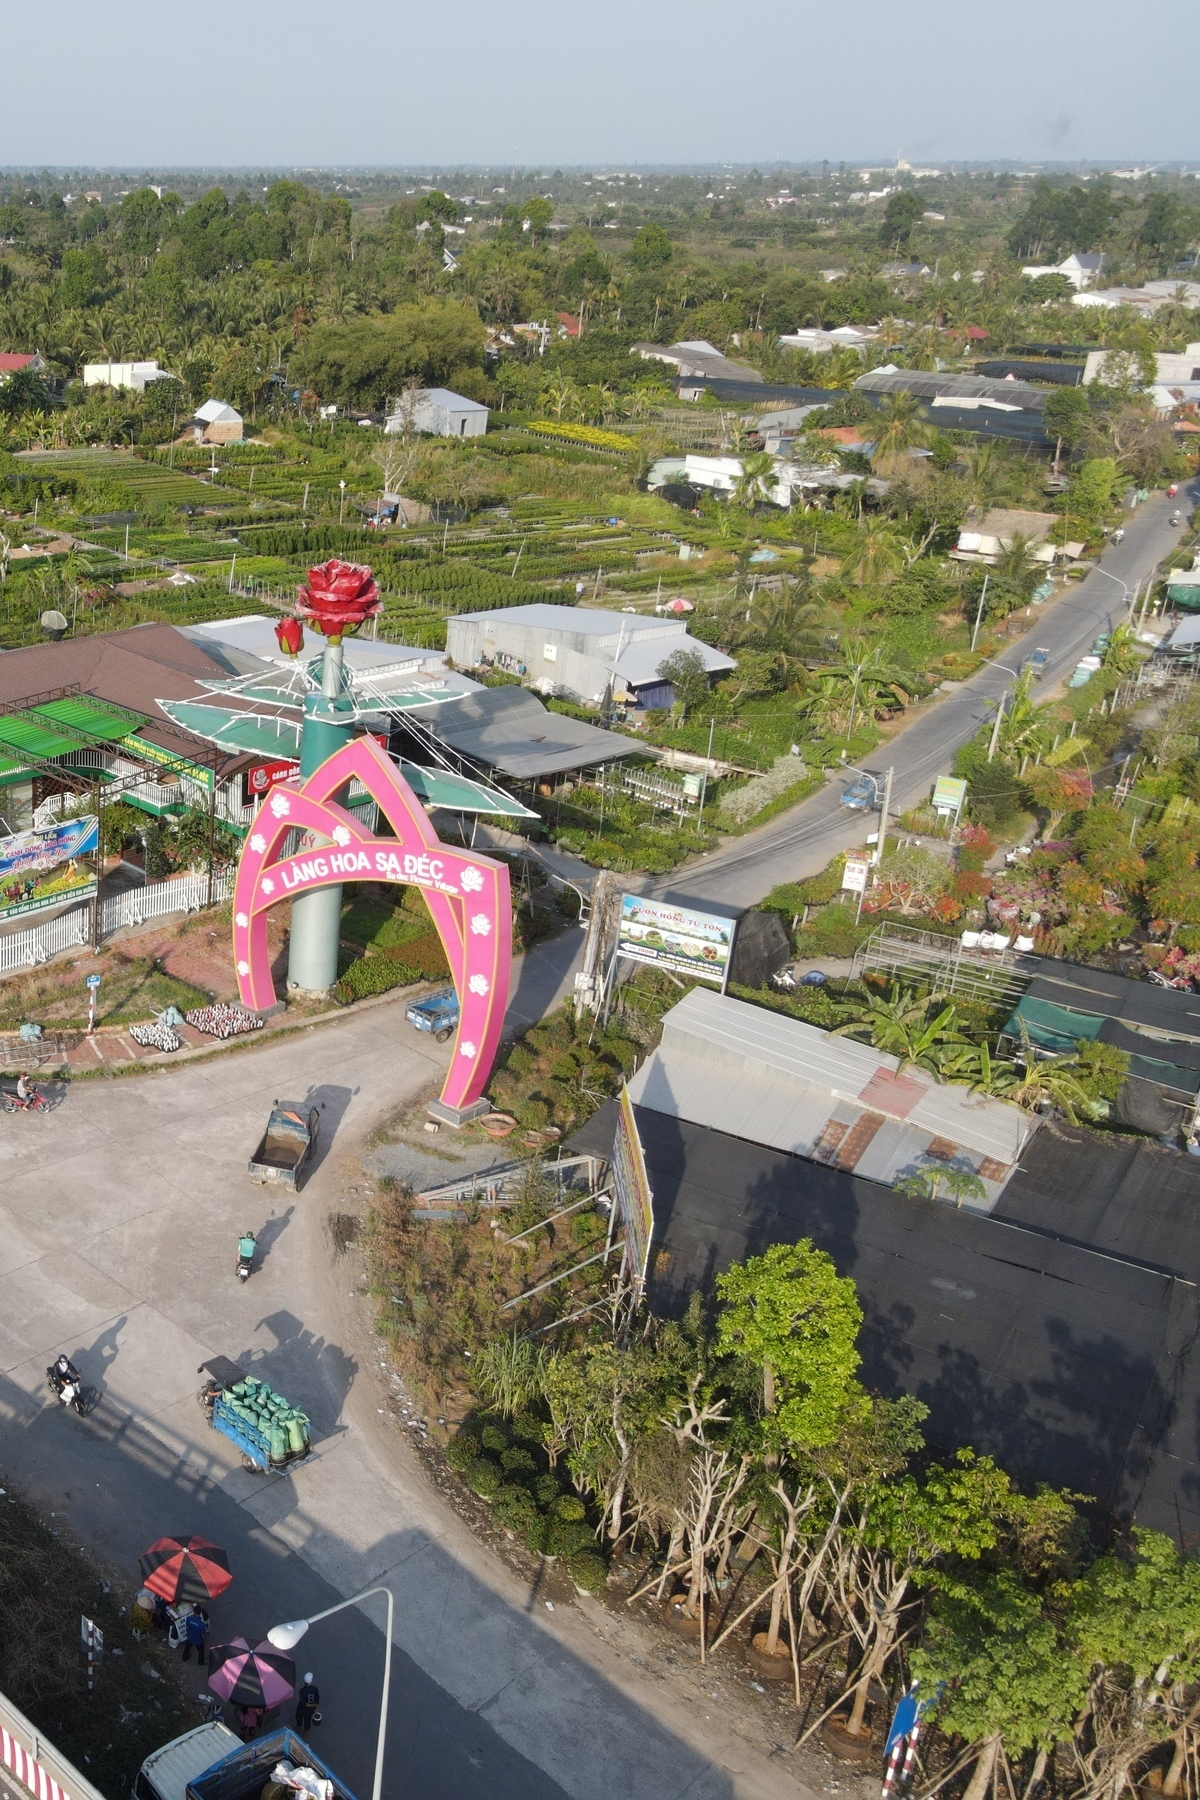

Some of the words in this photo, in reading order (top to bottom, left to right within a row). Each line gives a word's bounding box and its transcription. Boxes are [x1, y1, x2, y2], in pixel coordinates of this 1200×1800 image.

[281, 858, 330, 889] LÀNG
[330, 851, 371, 873] HOA
[375, 852, 400, 873] SA
[403, 853, 444, 880] ĐÉC
[386, 871, 397, 880] Sa
[410, 874, 433, 887] Flower
[434, 878, 459, 894] Village
